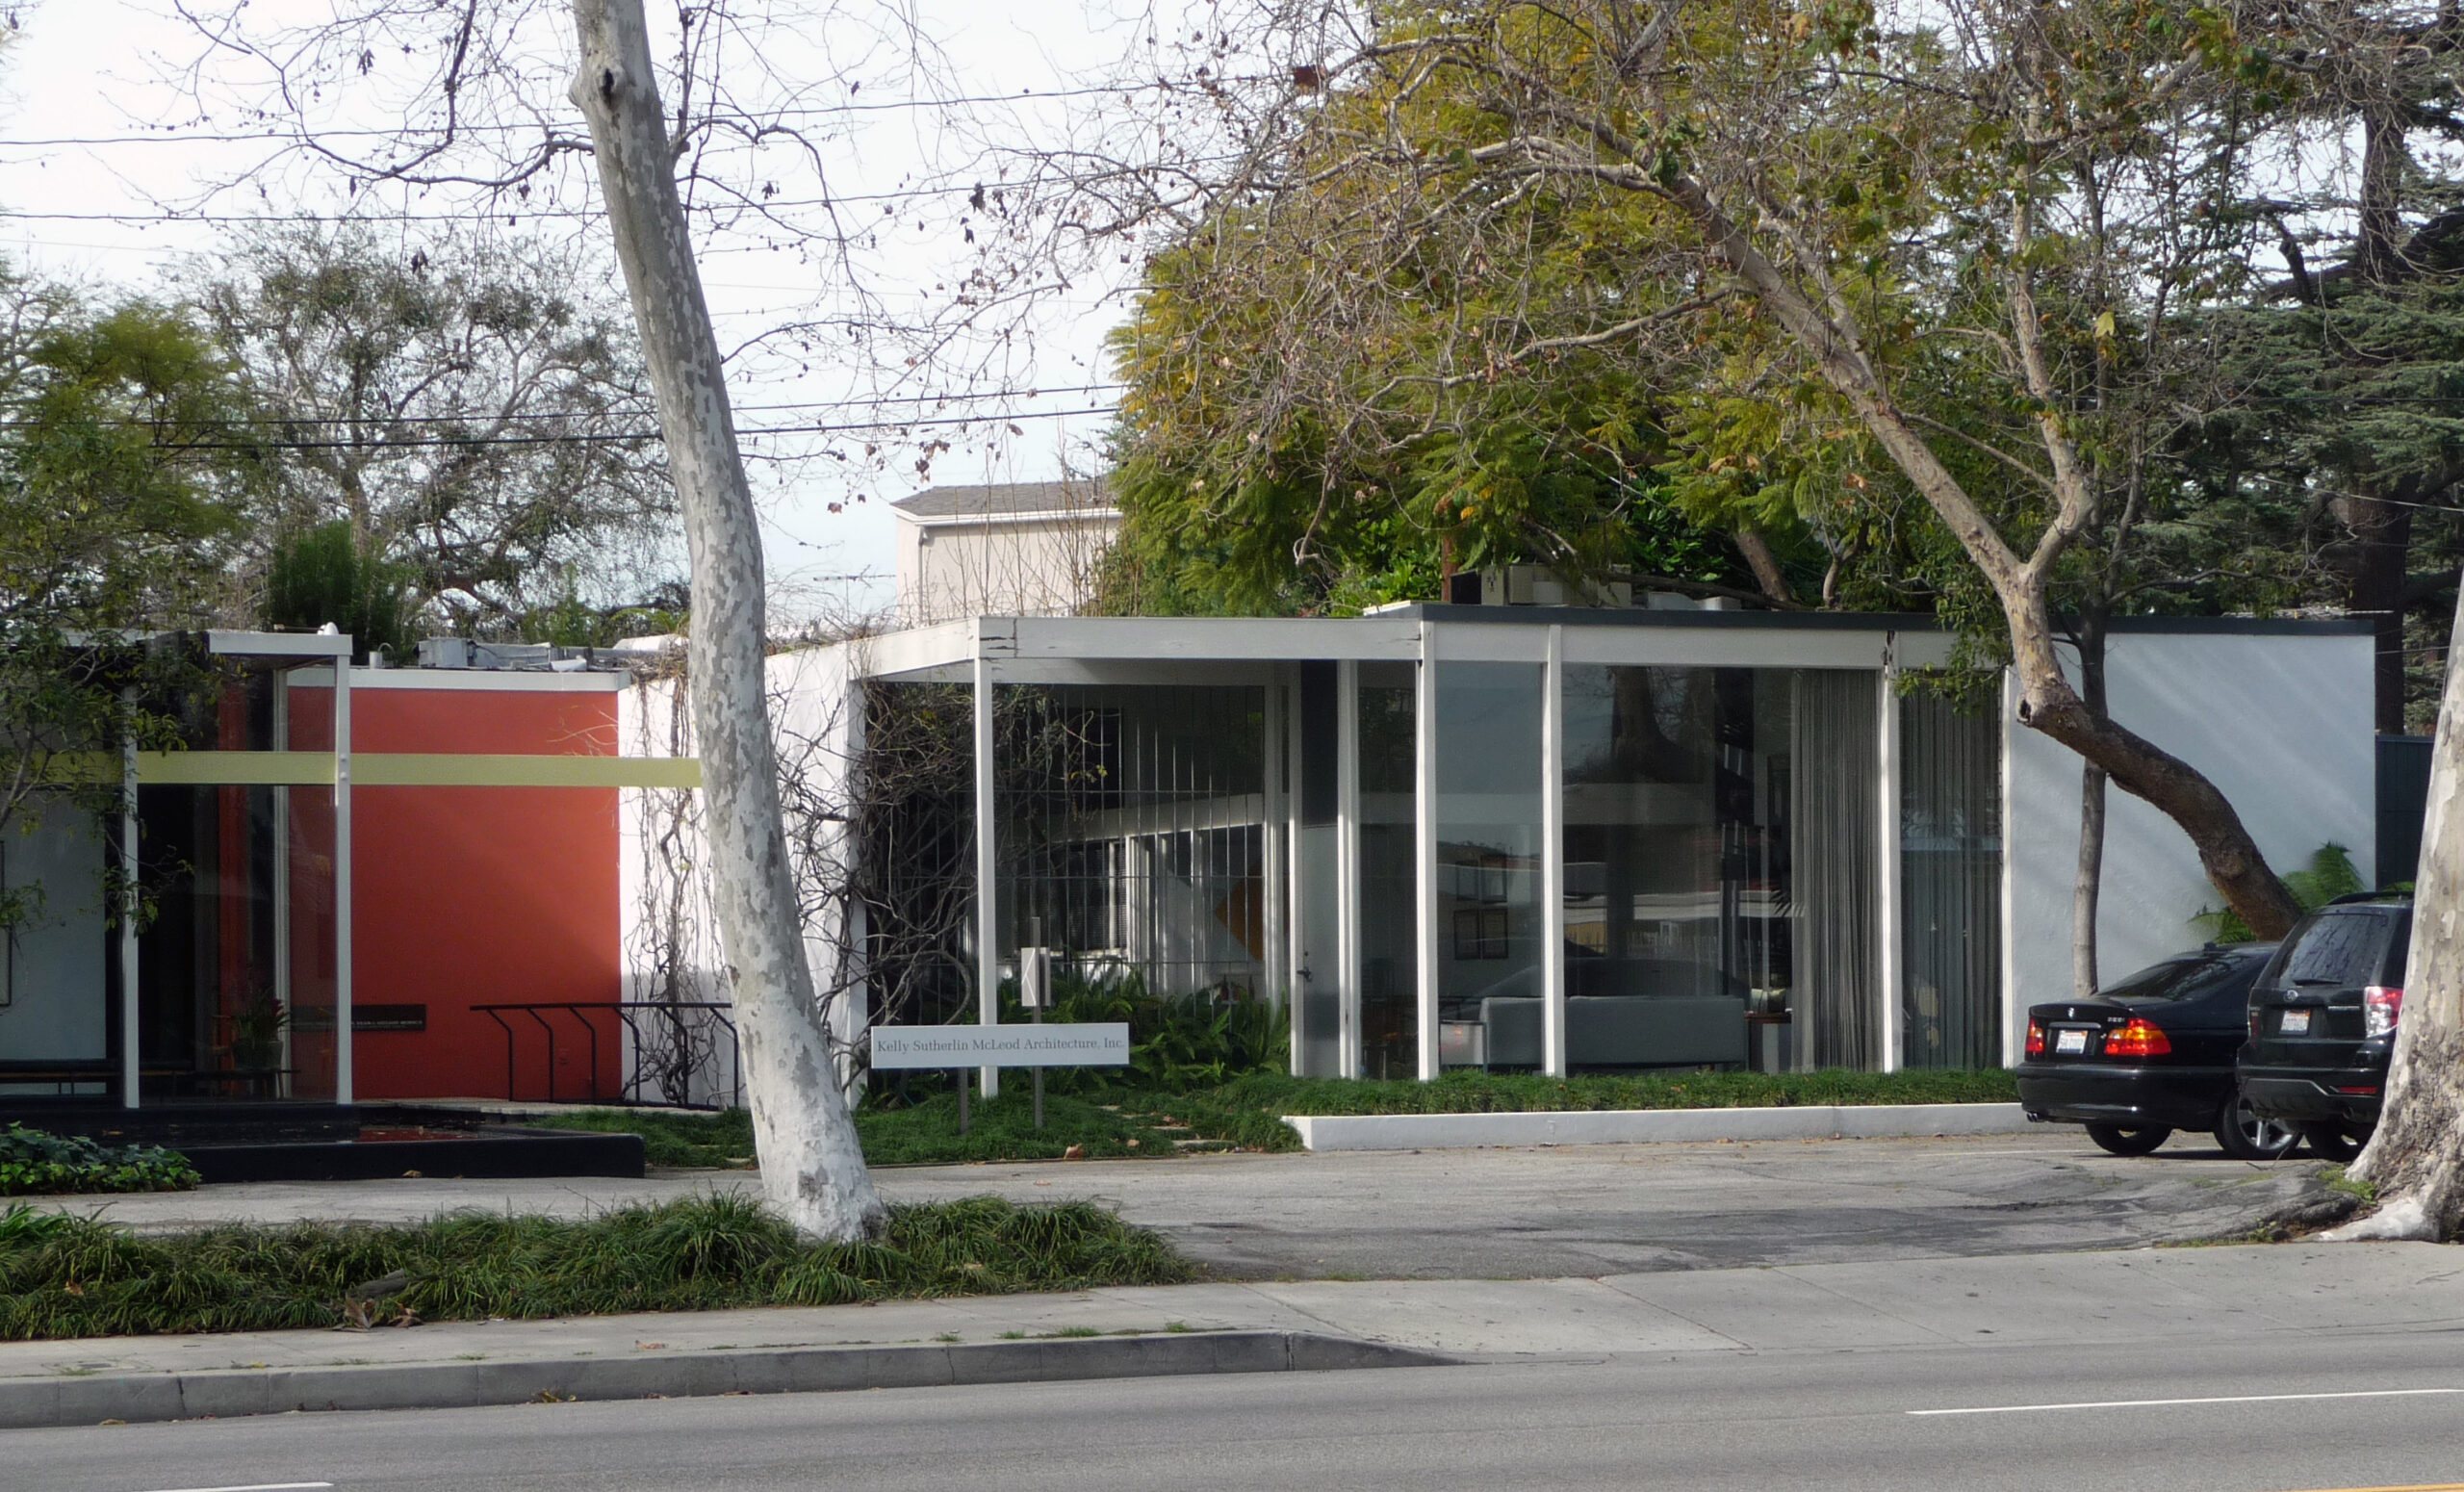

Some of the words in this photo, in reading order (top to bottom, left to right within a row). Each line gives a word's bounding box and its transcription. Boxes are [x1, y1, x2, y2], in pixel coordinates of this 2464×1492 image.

[877, 1040, 910, 1055] Kelly
[912, 1039, 968, 1052] Sutherlin
[972, 1038, 1020, 1051] McLeod
[1024, 1037, 1100, 1050] Architecture,
[1104, 1037, 1125, 1048] Inc.
